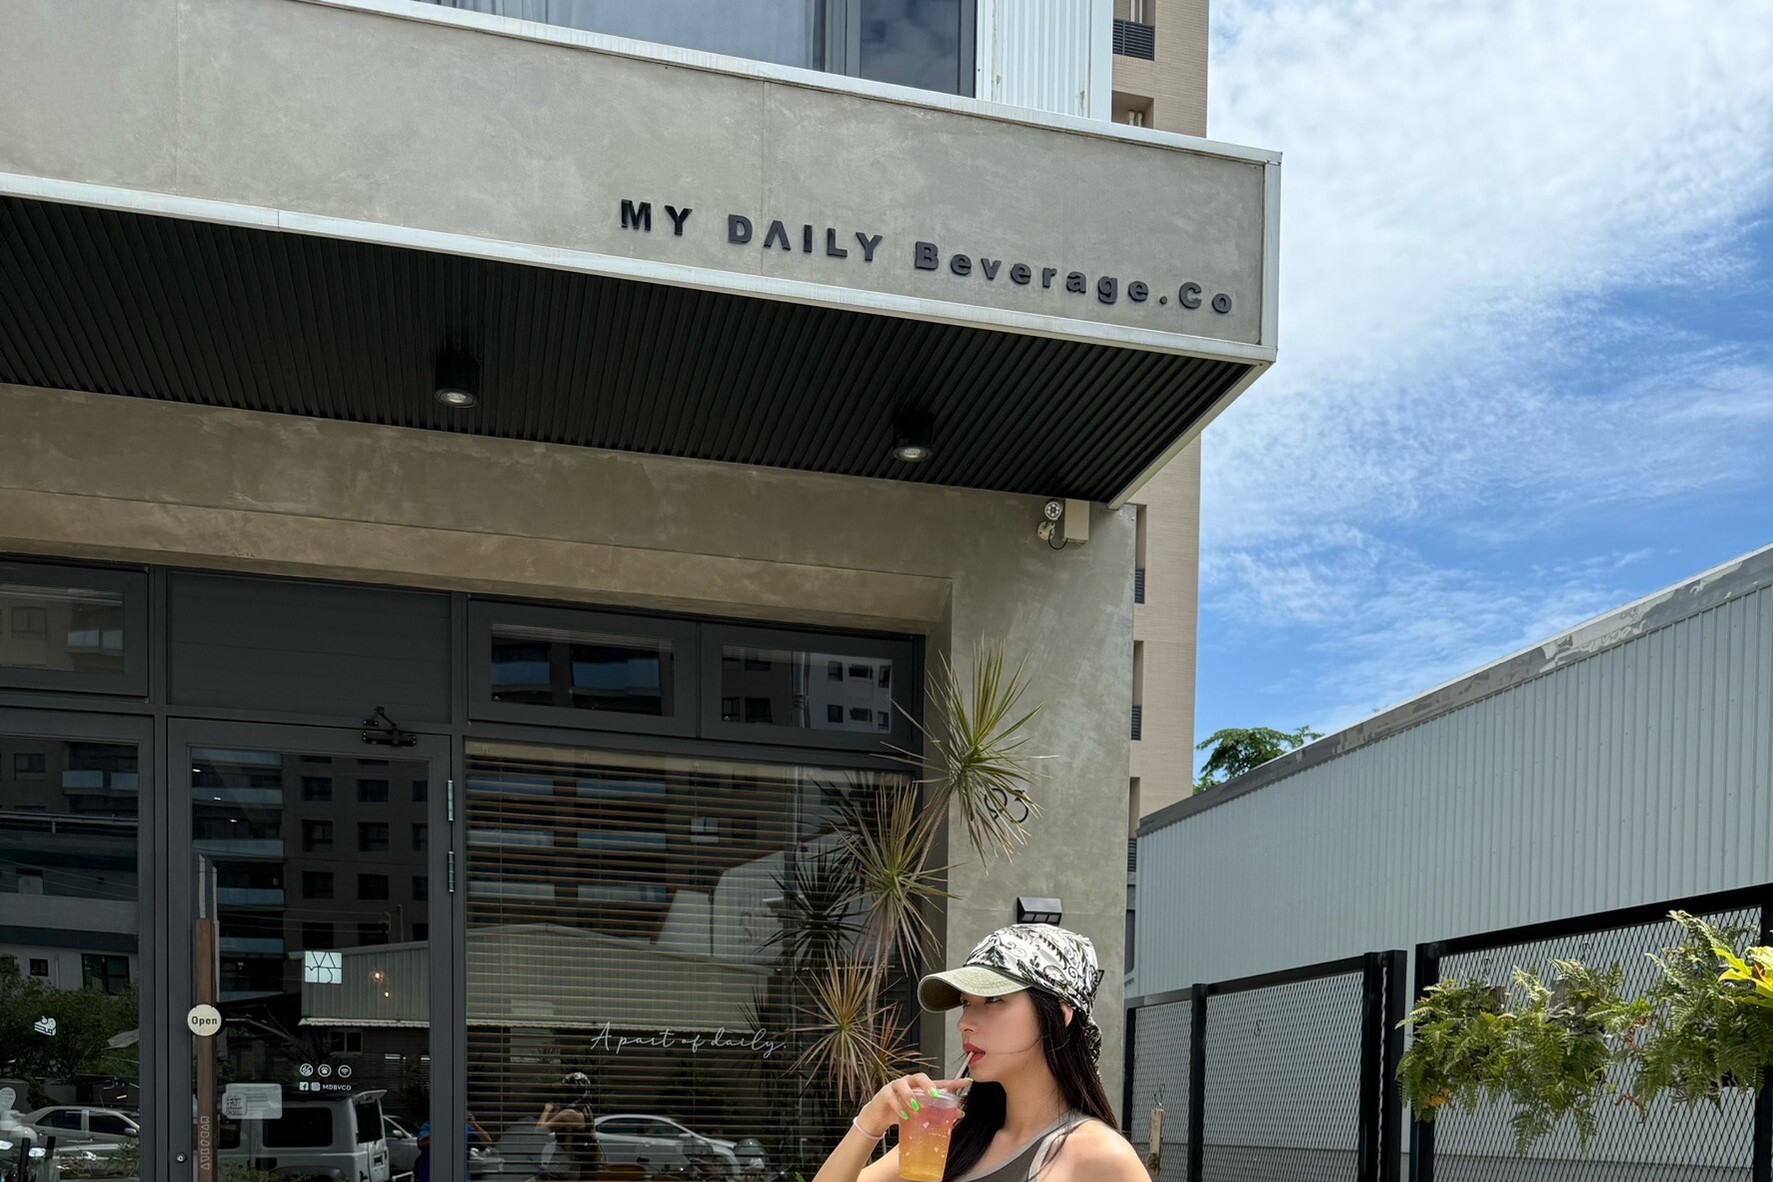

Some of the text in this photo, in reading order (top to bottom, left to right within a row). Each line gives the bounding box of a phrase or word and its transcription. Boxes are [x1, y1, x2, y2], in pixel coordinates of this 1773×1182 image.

[620, 199, 693, 236] MY
[191, 1015, 218, 1026] Open
[590, 1021, 612, 1051] A
[616, 1028, 676, 1054] part
[681, 1034, 706, 1053] of
